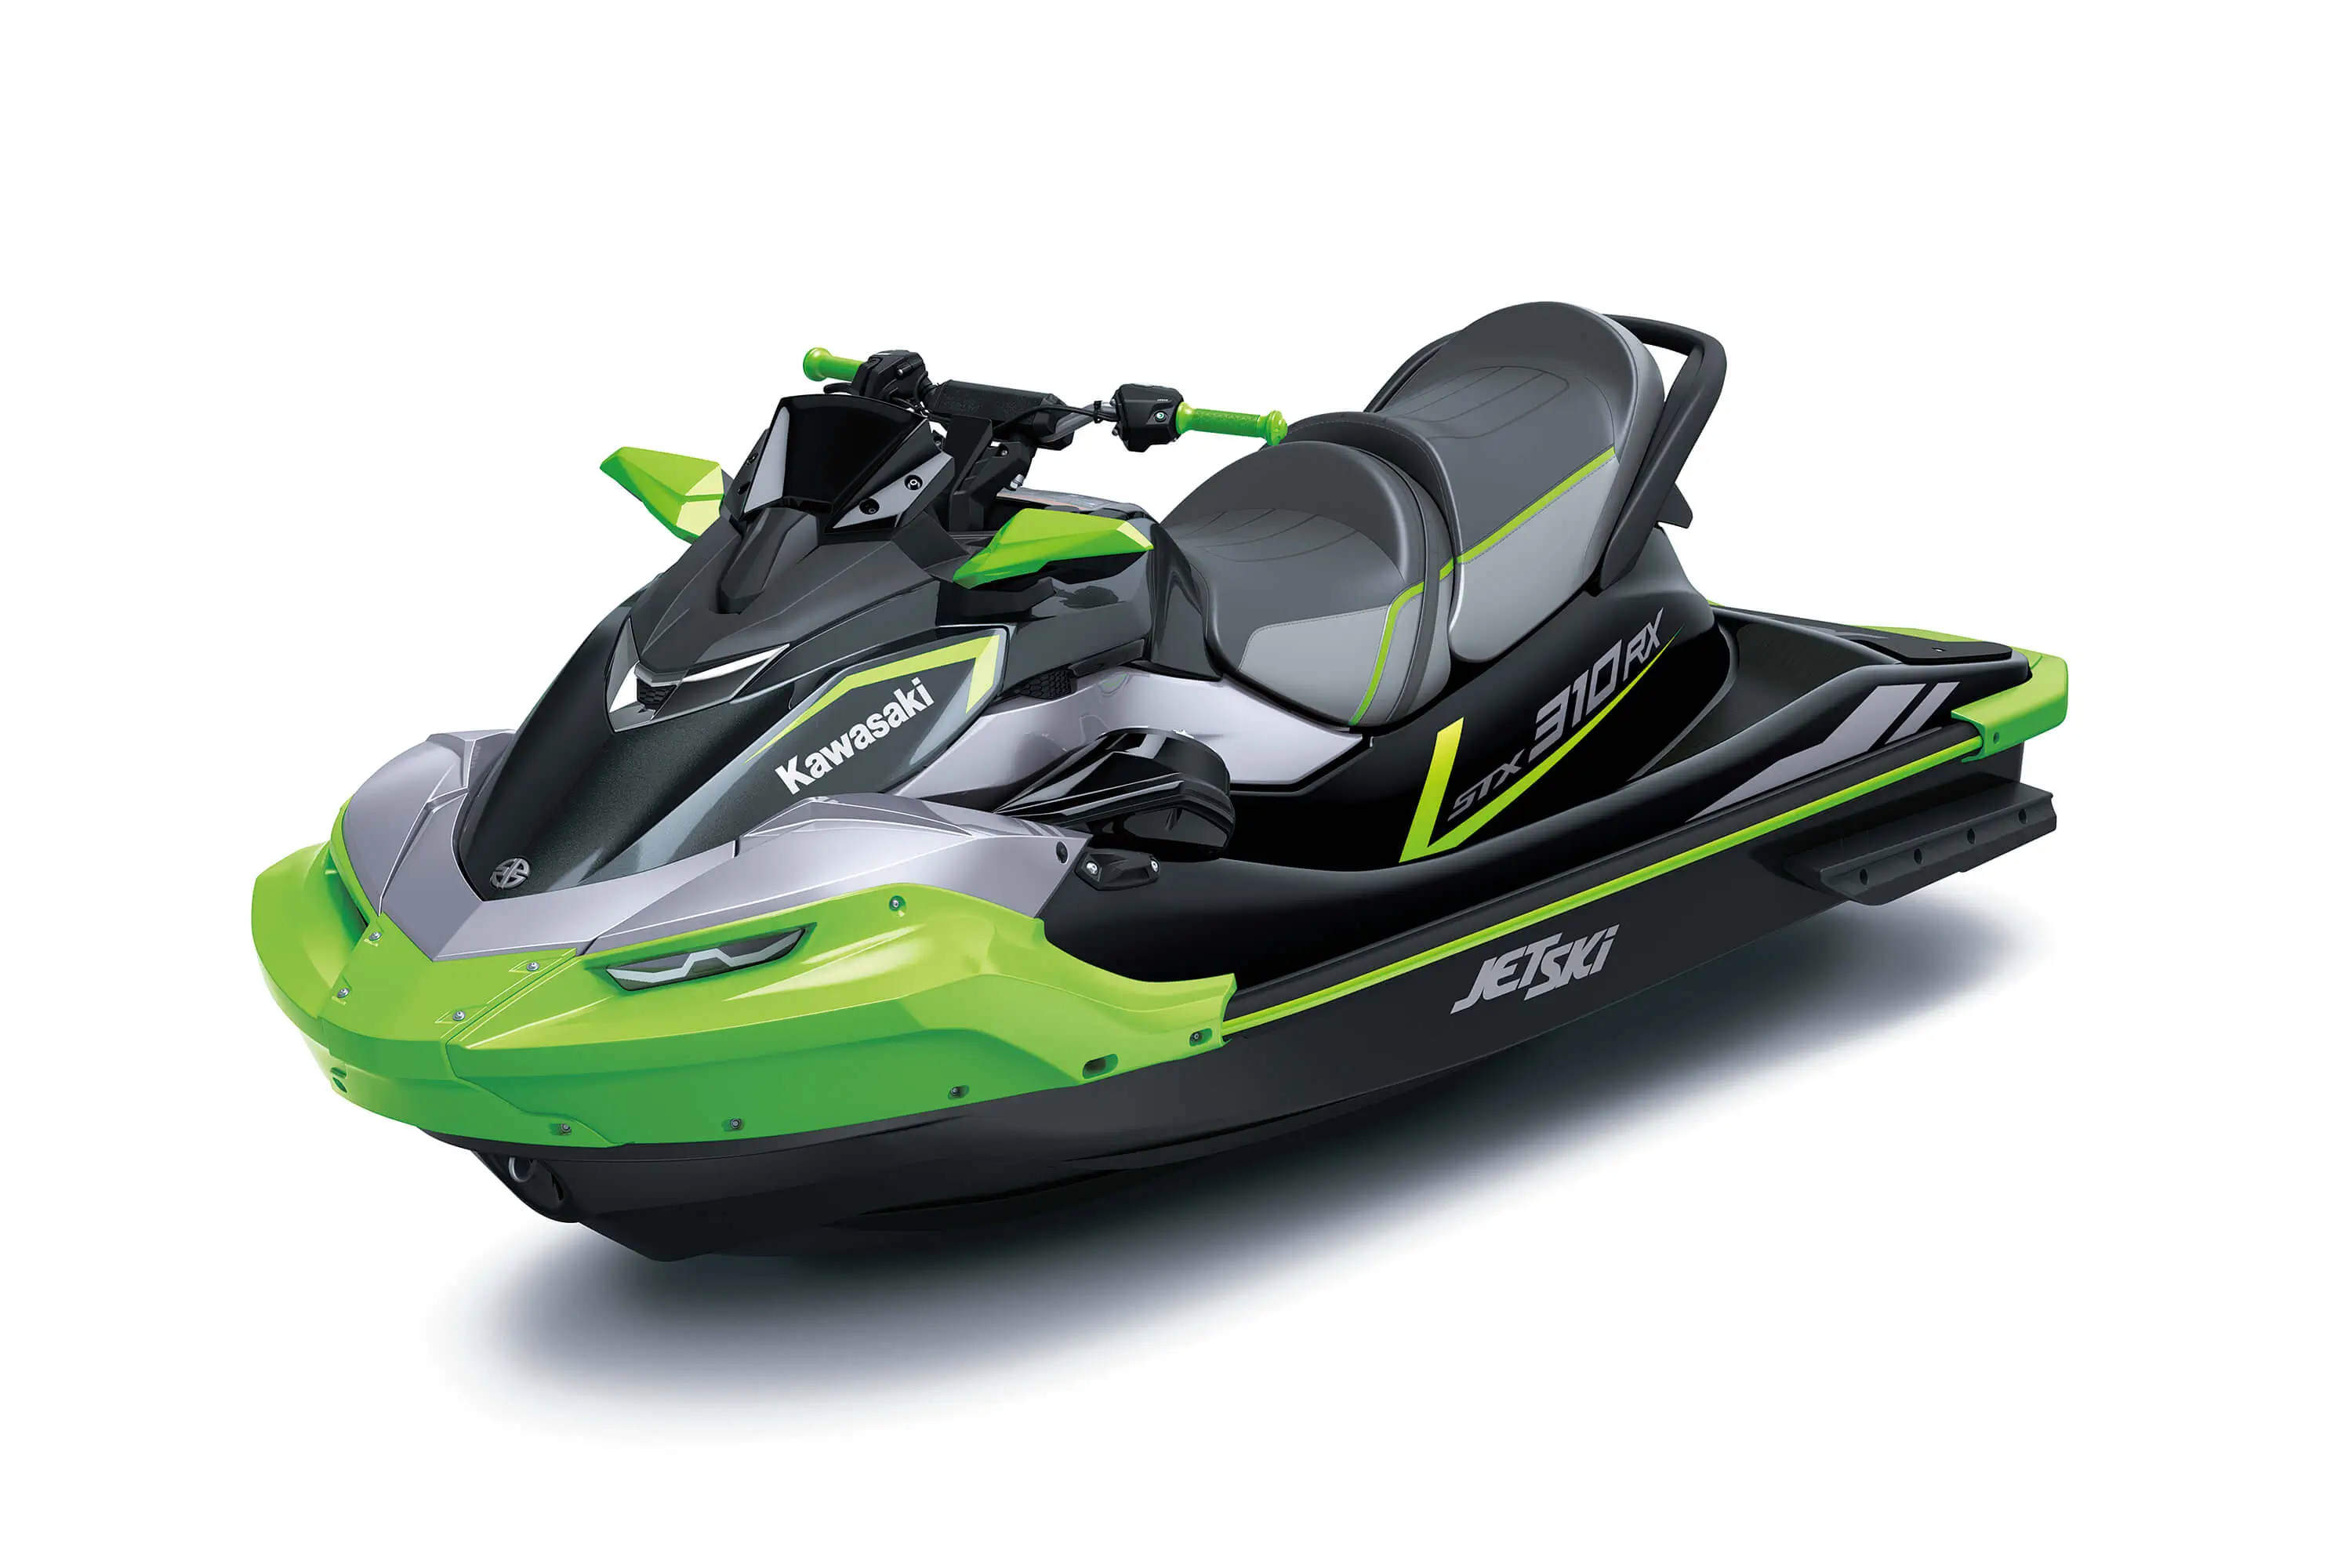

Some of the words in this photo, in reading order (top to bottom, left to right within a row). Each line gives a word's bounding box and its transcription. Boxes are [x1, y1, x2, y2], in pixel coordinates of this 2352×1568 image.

[775, 677, 935, 795] Kawasaki
[1447, 749, 1525, 822] STX
[1528, 639, 1622, 763] 310
[1623, 607, 1664, 682] RX
